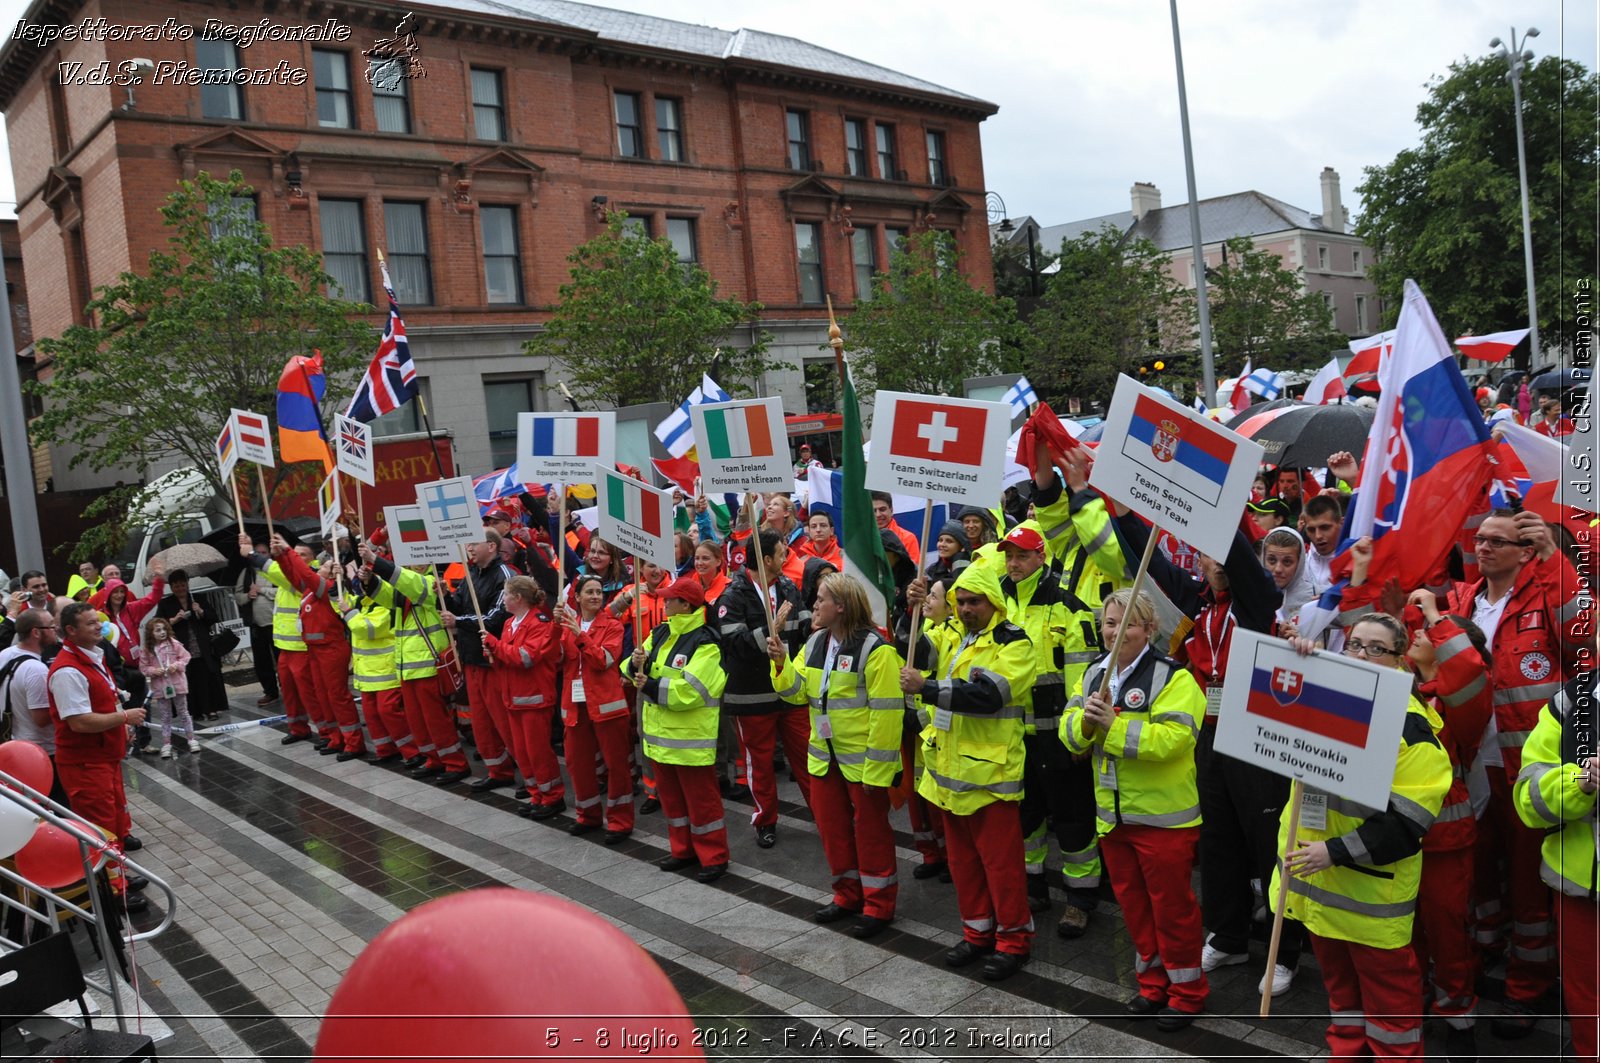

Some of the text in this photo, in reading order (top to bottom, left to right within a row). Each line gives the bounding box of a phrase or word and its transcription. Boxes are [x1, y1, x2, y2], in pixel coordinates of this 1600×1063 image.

[721, 463, 767, 473] Team Ireland
[890, 462, 978, 482] Team Switzerland
[711, 476, 740, 485] Foireann
[751, 473, 783, 484] hÉireann
[897, 477, 967, 495] Team Schweiz
[1129, 486, 1162, 511] Србија
[1135, 472, 1193, 513] Team Serbia
[616, 525, 633, 538] Team
[633, 533, 648, 546] Italy
[616, 535, 632, 547] Team
[633, 542, 649, 555] Italia
[1256, 725, 1348, 765] Team Slovakia
[1253, 742, 1345, 783] Tím Slovensko
